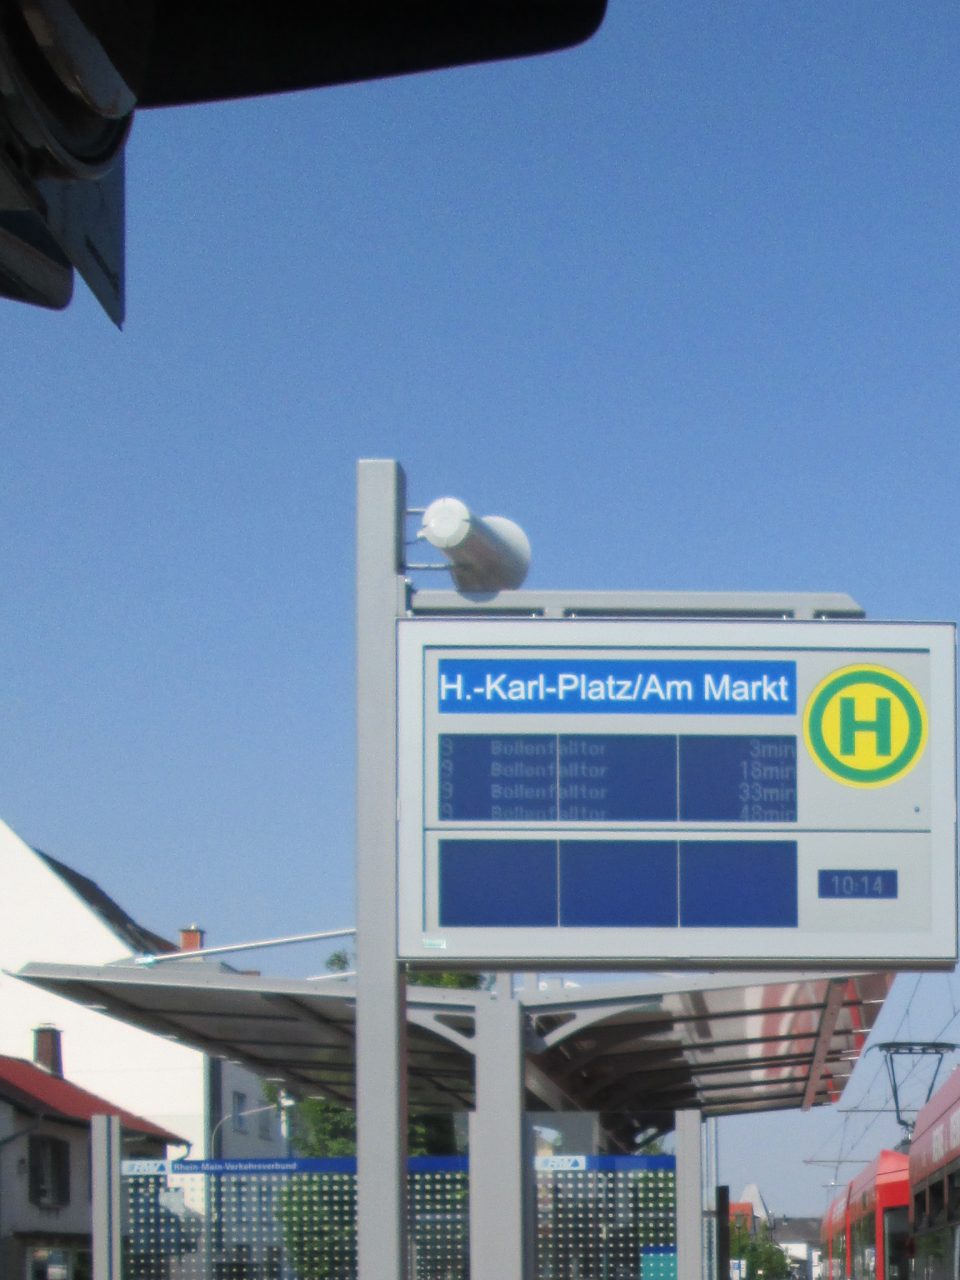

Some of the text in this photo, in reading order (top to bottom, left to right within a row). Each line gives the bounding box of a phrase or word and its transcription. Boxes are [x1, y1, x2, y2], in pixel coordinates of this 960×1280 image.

[440, 673, 789, 701] H.-Karl-Platz/Am Markt
[839, 696, 892, 757] H
